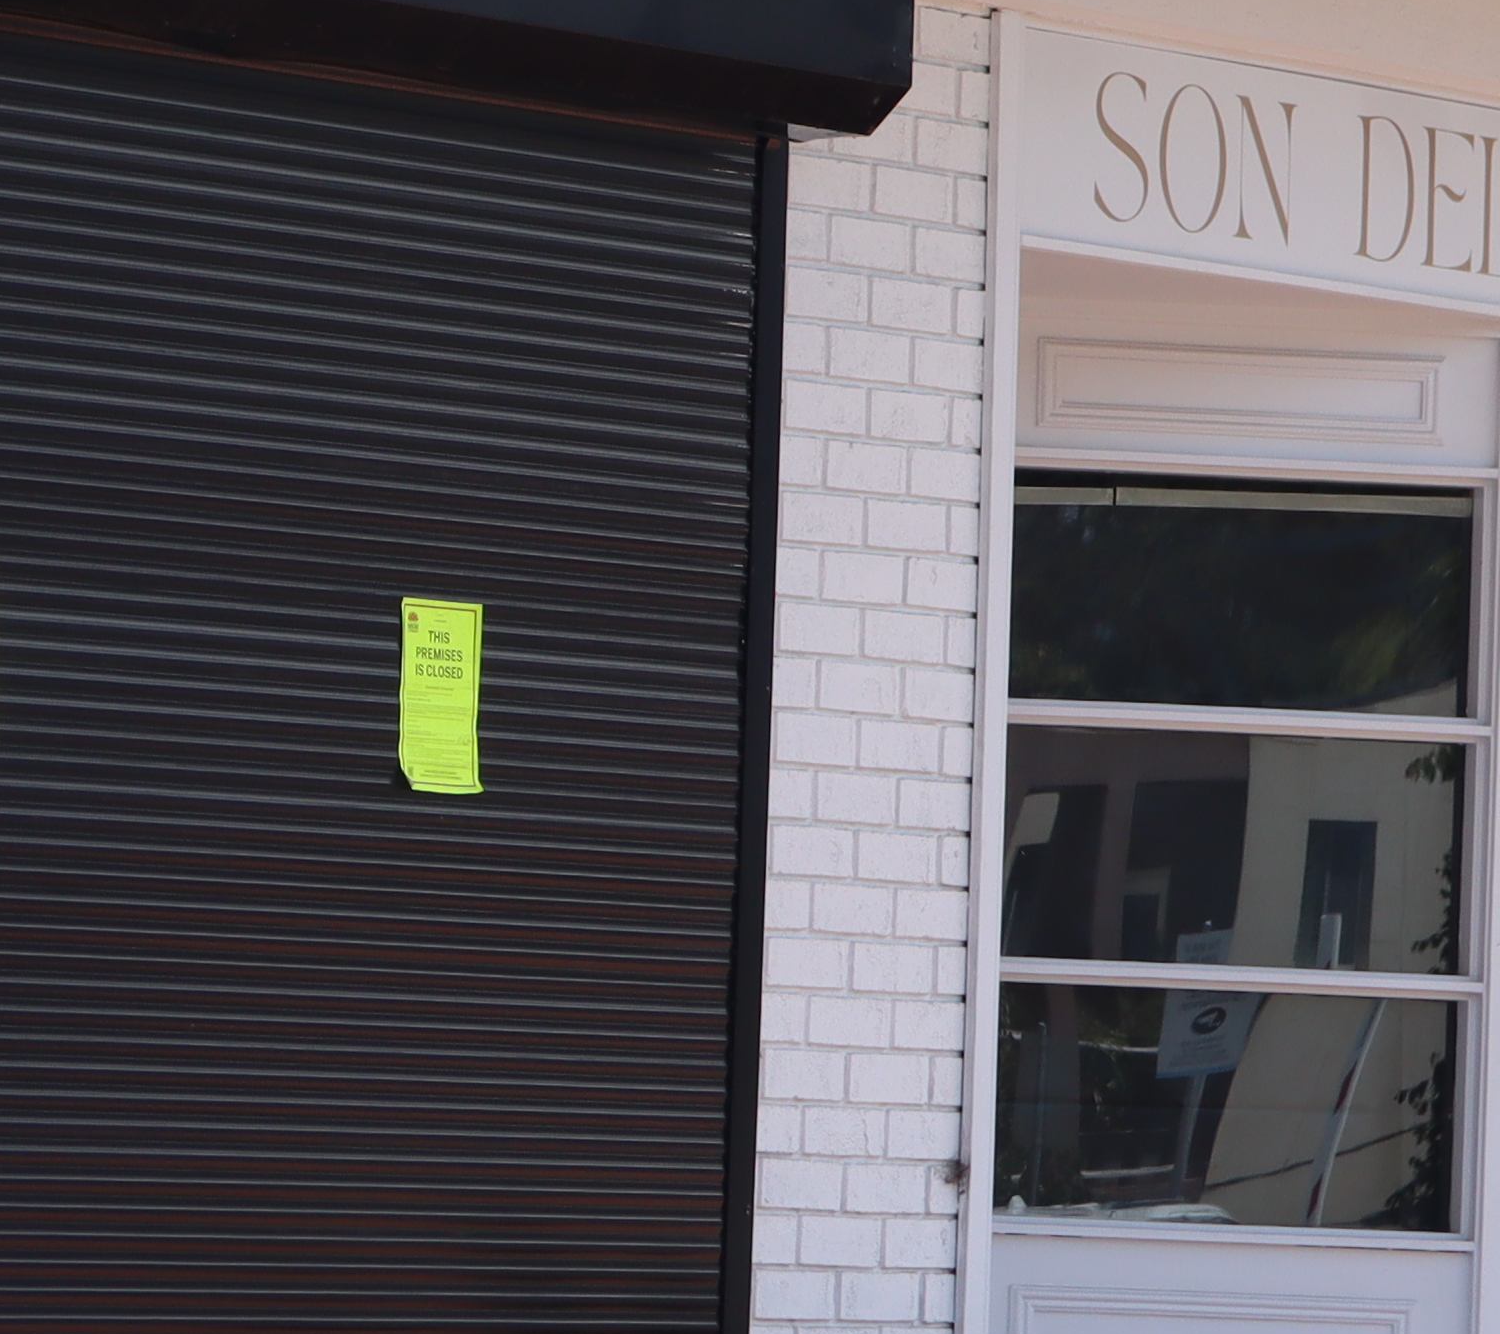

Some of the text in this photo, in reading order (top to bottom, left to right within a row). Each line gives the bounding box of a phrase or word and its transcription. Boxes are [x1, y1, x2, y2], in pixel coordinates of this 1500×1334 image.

[1093, 71, 1298, 248] SON
[428, 630, 450, 644] THIS
[415, 646, 463, 662] PREMISES
[415, 663, 464, 679] IS CLOSED
